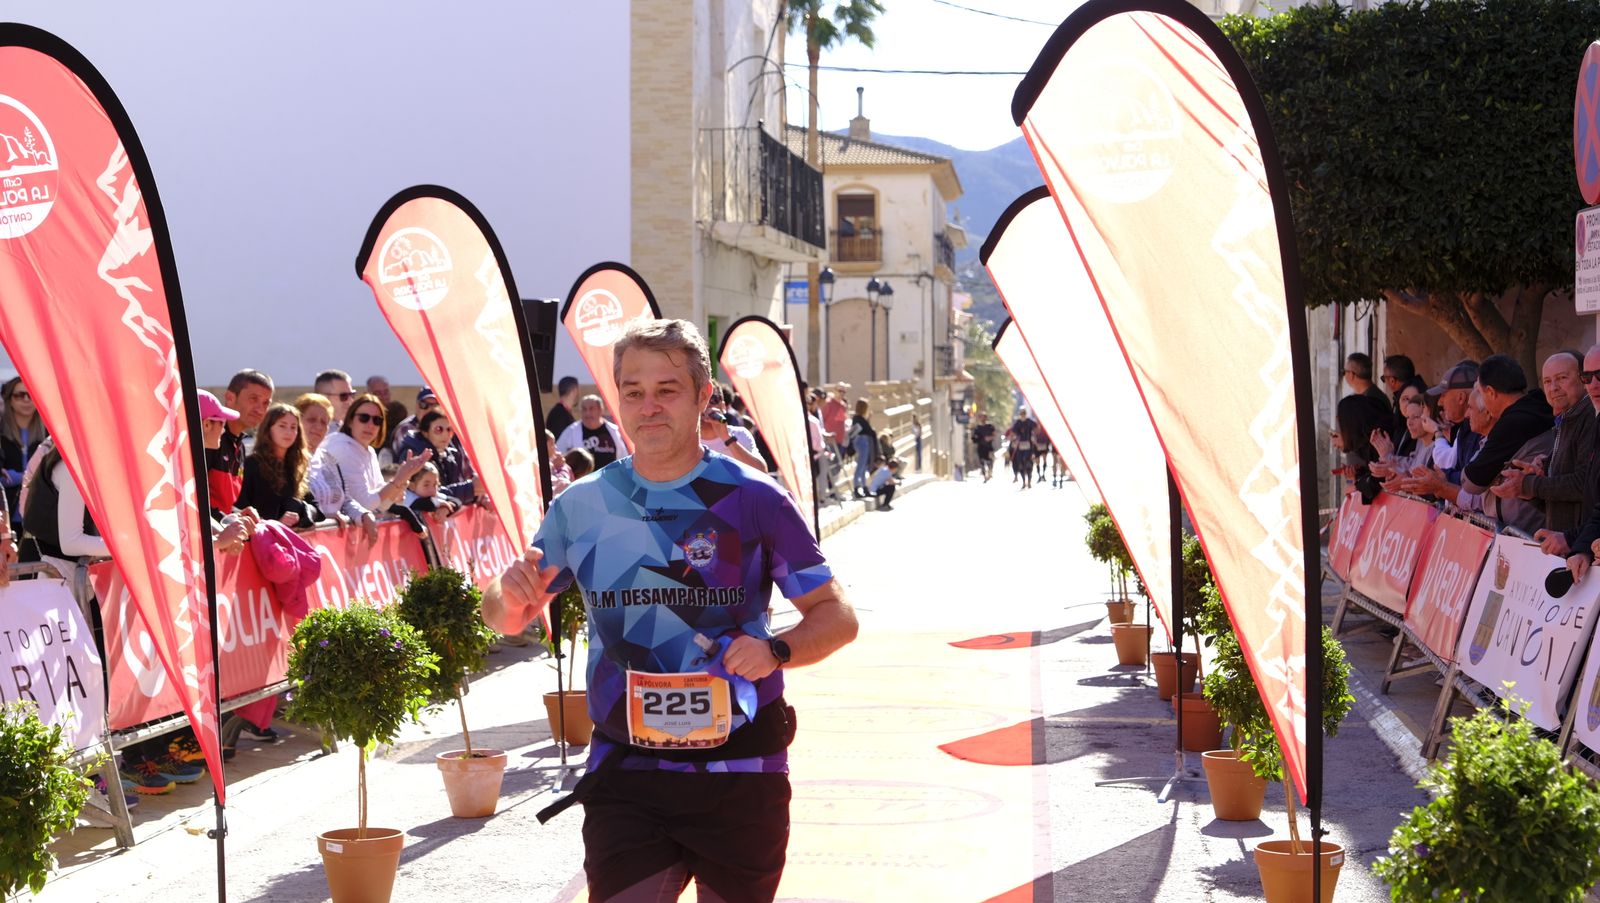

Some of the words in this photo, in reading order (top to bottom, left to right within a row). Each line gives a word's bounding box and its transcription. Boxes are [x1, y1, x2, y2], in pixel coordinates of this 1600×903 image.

[1374, 529, 1417, 581] VEOLIA
[621, 585, 746, 607] DESAMPARADOS
[1430, 556, 1473, 623] VEOLIA
[40, 621, 71, 647] DE
[216, 586, 281, 653] OLIA
[0, 655, 87, 713] RIA
[643, 691, 711, 716] 225
